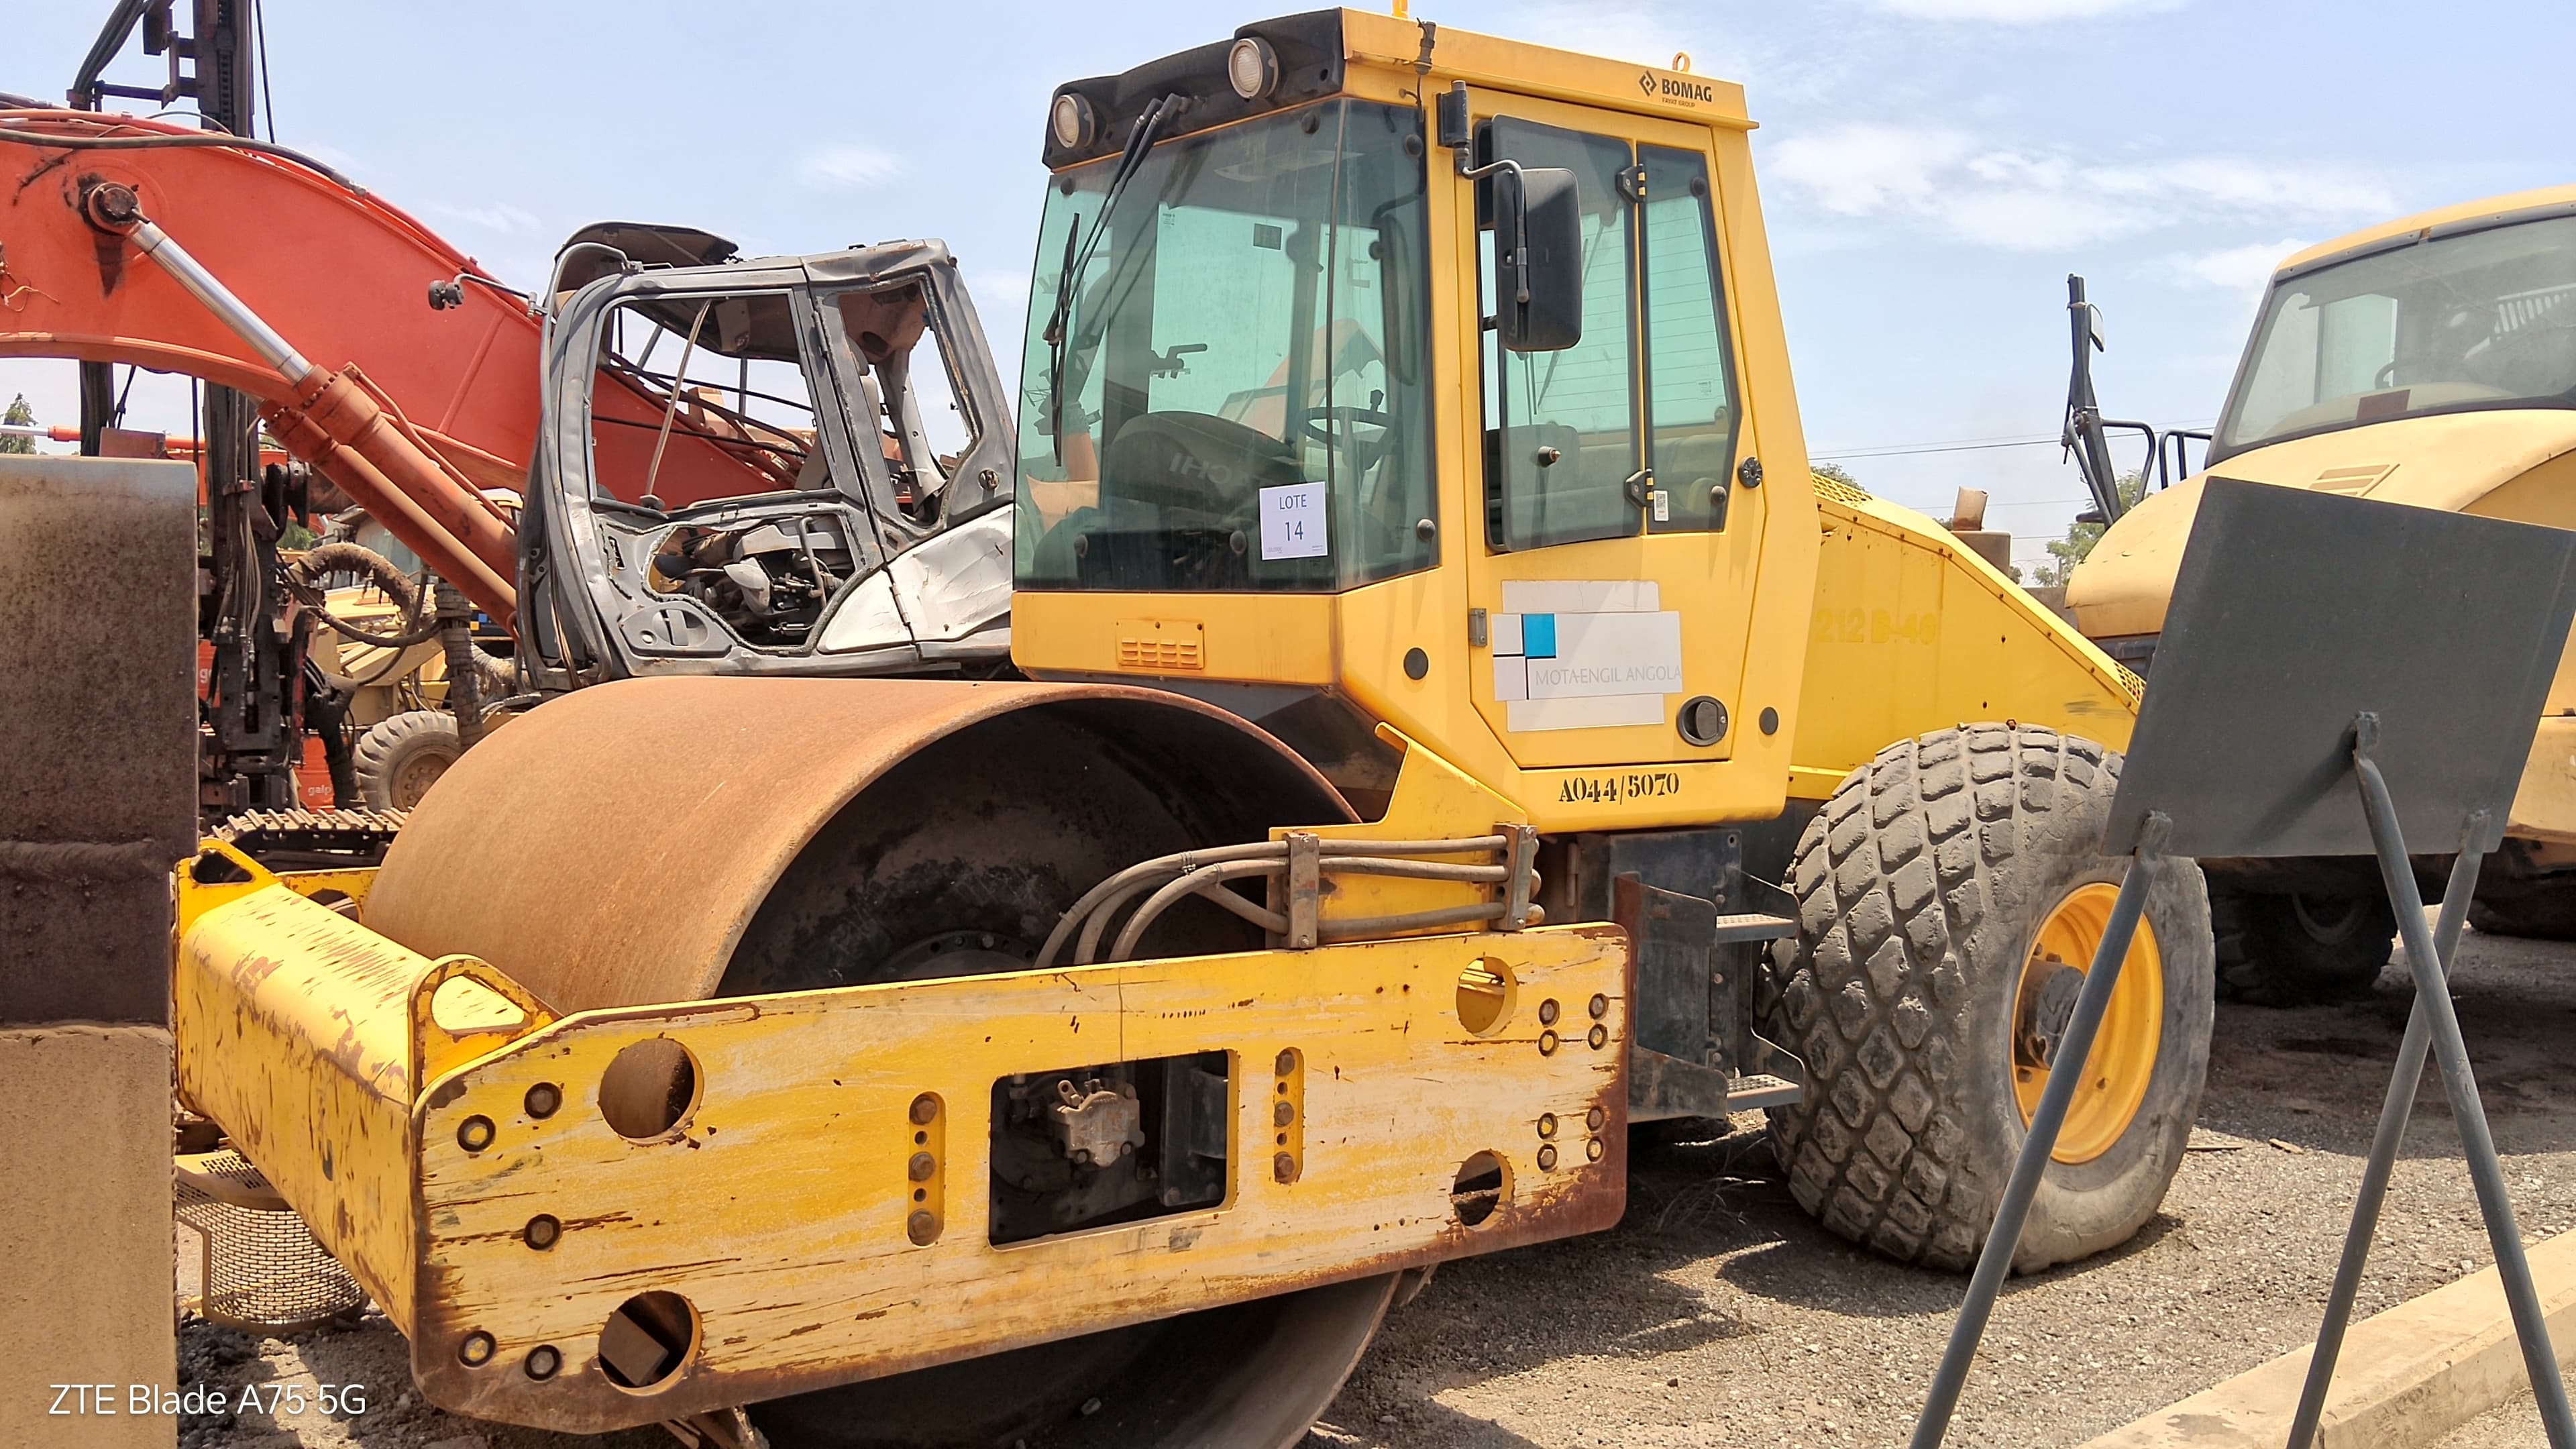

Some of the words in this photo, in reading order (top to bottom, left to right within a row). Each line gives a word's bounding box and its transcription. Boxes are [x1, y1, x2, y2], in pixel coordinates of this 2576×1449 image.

[1662, 78, 1712, 102] BOMAG
[1279, 494, 1307, 510] LOTE
[1285, 521, 1304, 541] 14
[1815, 608, 1864, 643] 212
[1626, 665, 1681, 682] ANGOLA
[307, 784, 333, 797] galp
[1558, 772, 1680, 806] A044/5070
